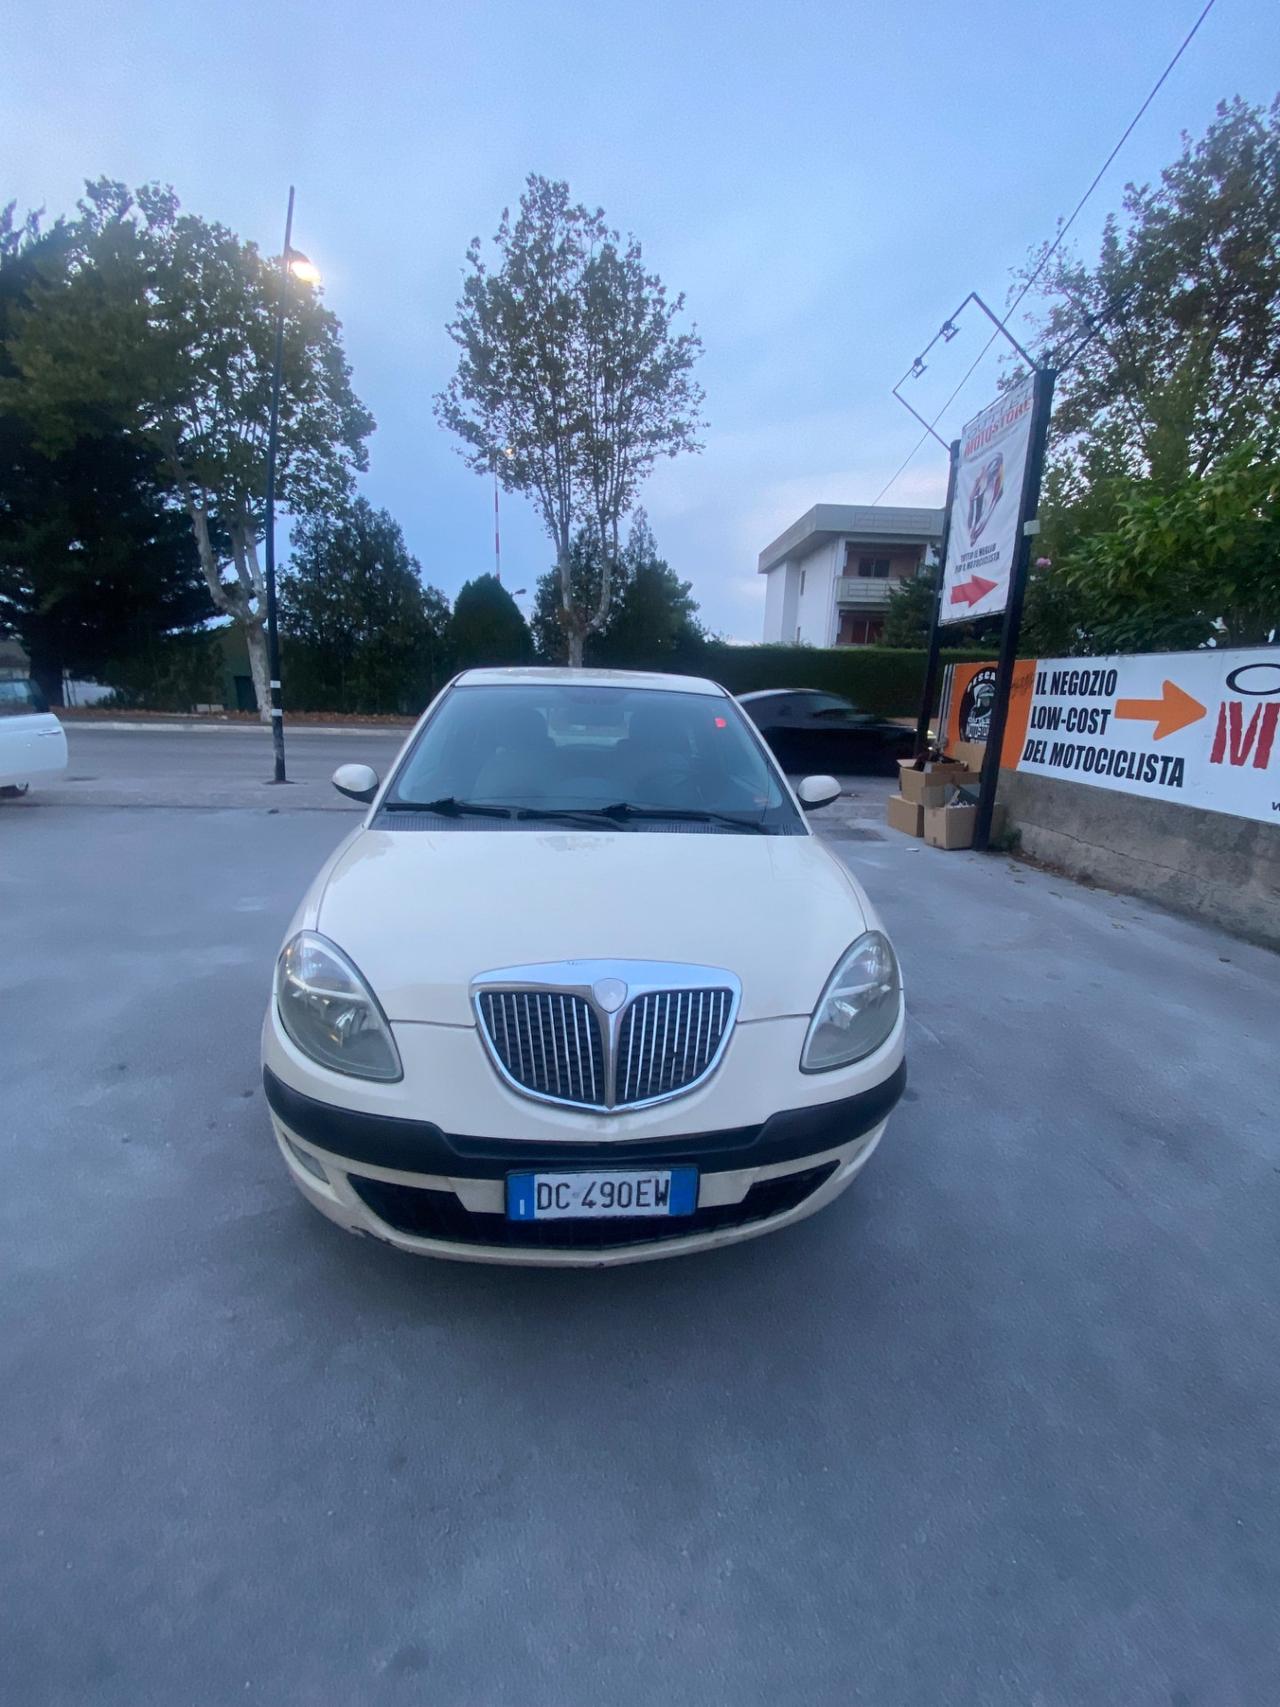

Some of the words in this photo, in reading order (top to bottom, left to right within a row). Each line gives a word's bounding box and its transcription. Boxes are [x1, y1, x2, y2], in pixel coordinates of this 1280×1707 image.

[1035, 671, 1047, 696] IL
[1050, 669, 1118, 697] NEGOZIO
[1030, 705, 1112, 736] LOW-COST
[1022, 738, 1046, 764] DEL
[1049, 742, 1185, 788] MOTOCICLISTA
[536, 1182, 571, 1210] DC
[581, 1179, 670, 1209] 490EW
